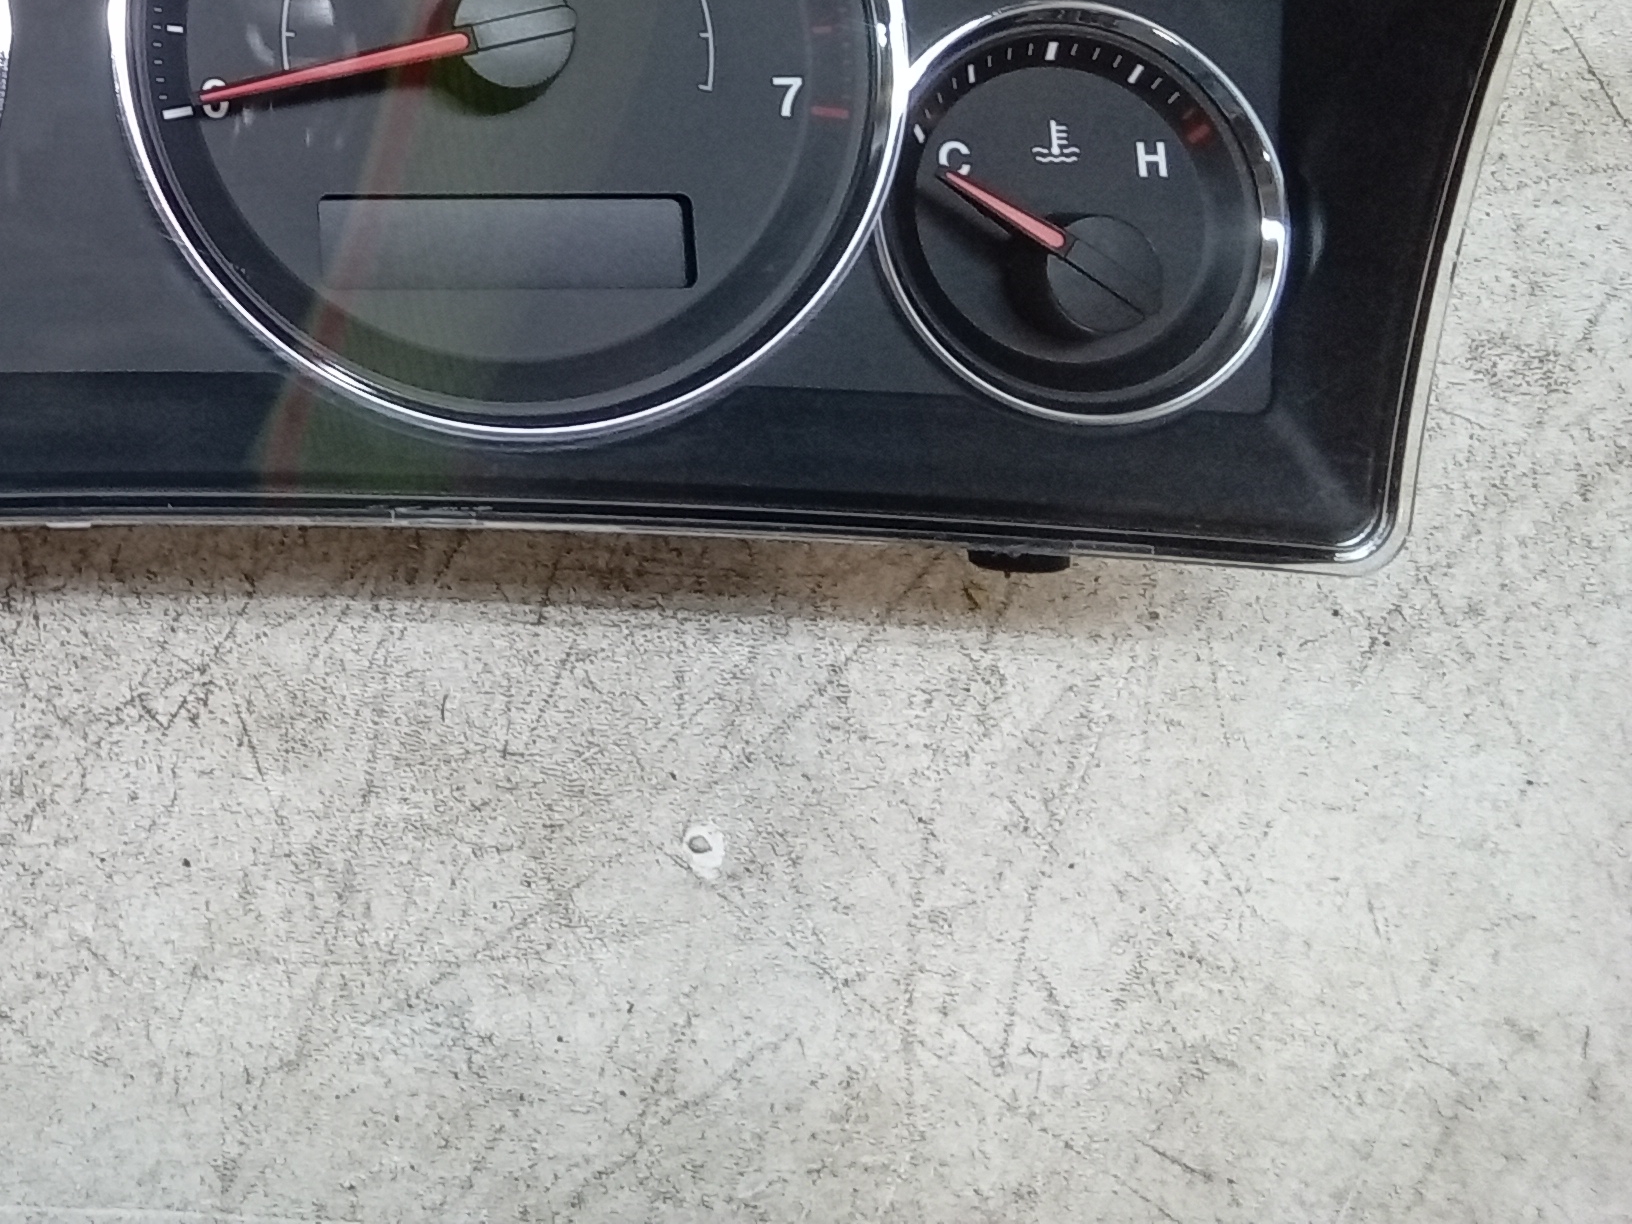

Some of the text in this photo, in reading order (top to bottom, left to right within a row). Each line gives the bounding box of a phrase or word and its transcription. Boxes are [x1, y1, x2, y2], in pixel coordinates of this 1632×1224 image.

[772, 76, 803, 117] 7
[939, 141, 970, 176] C
[1135, 141, 1168, 178] H
